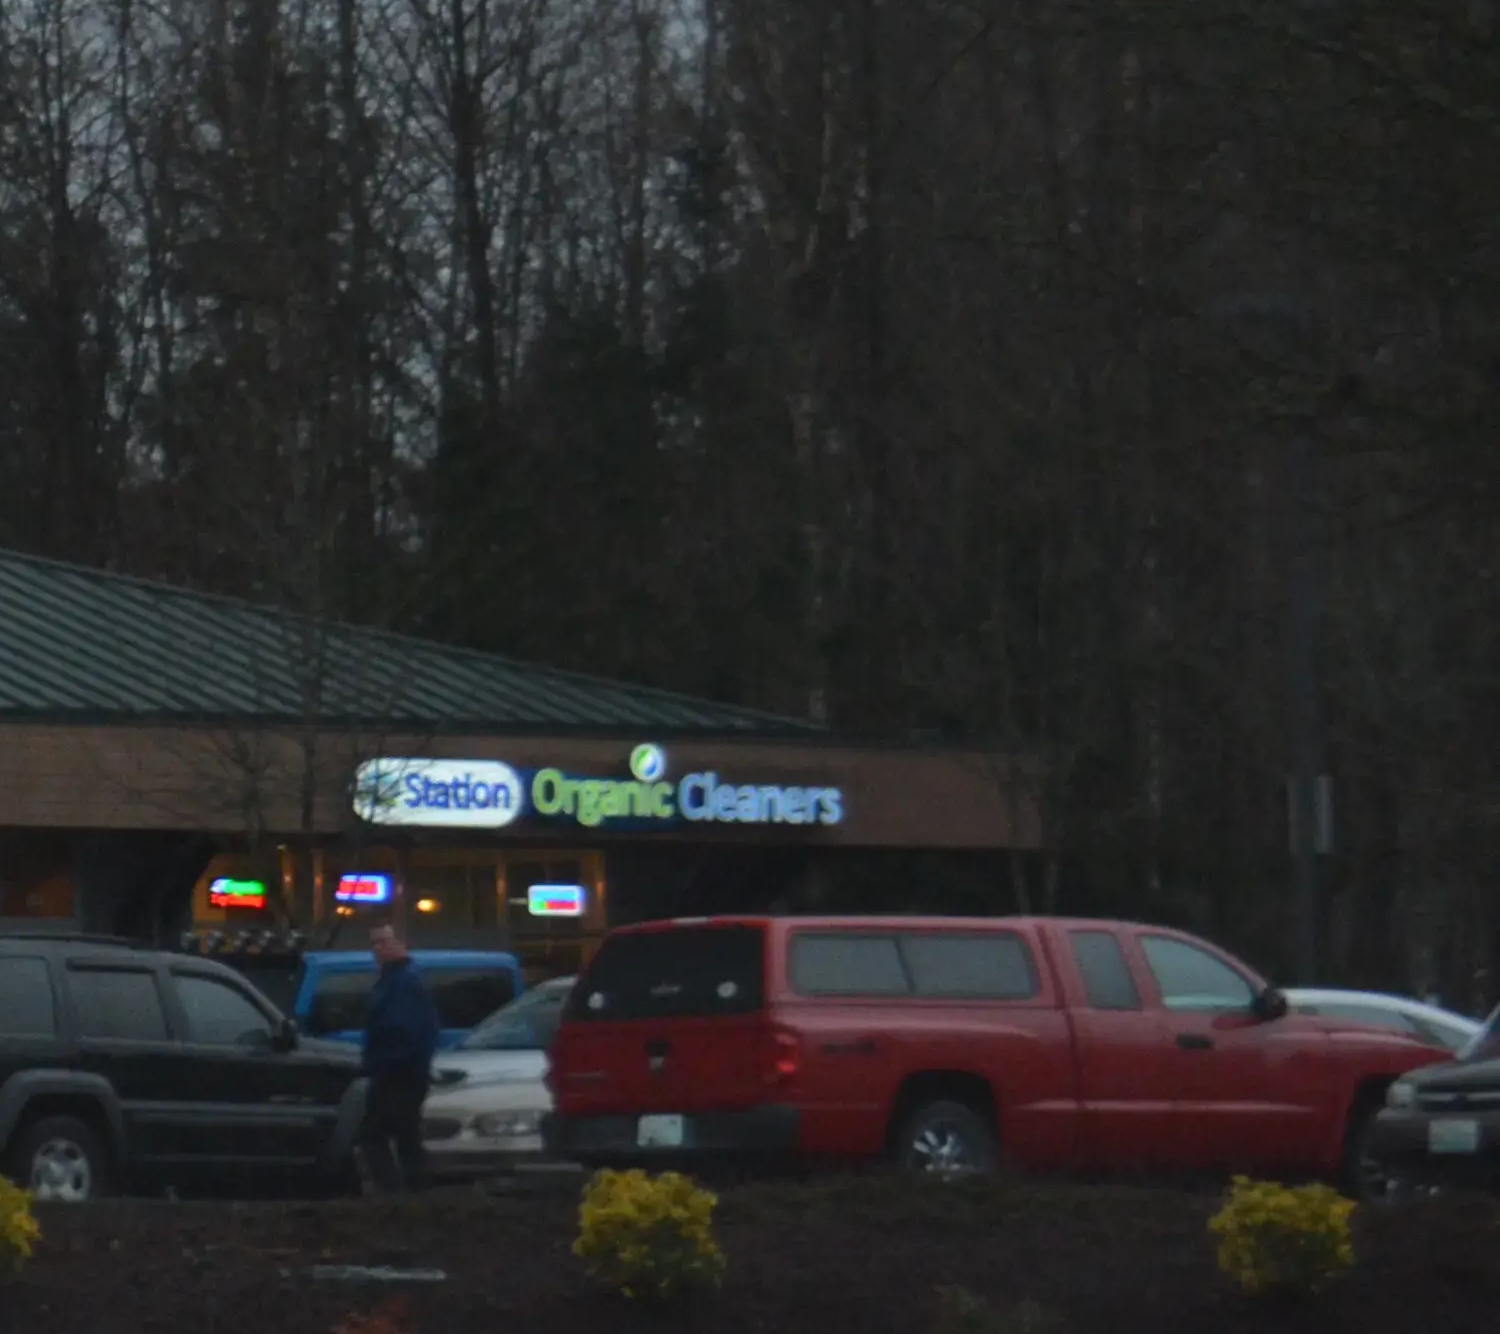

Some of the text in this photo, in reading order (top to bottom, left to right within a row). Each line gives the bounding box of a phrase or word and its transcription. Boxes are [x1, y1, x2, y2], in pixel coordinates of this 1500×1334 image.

[404, 767, 843, 826] Station Organic Cleaners
